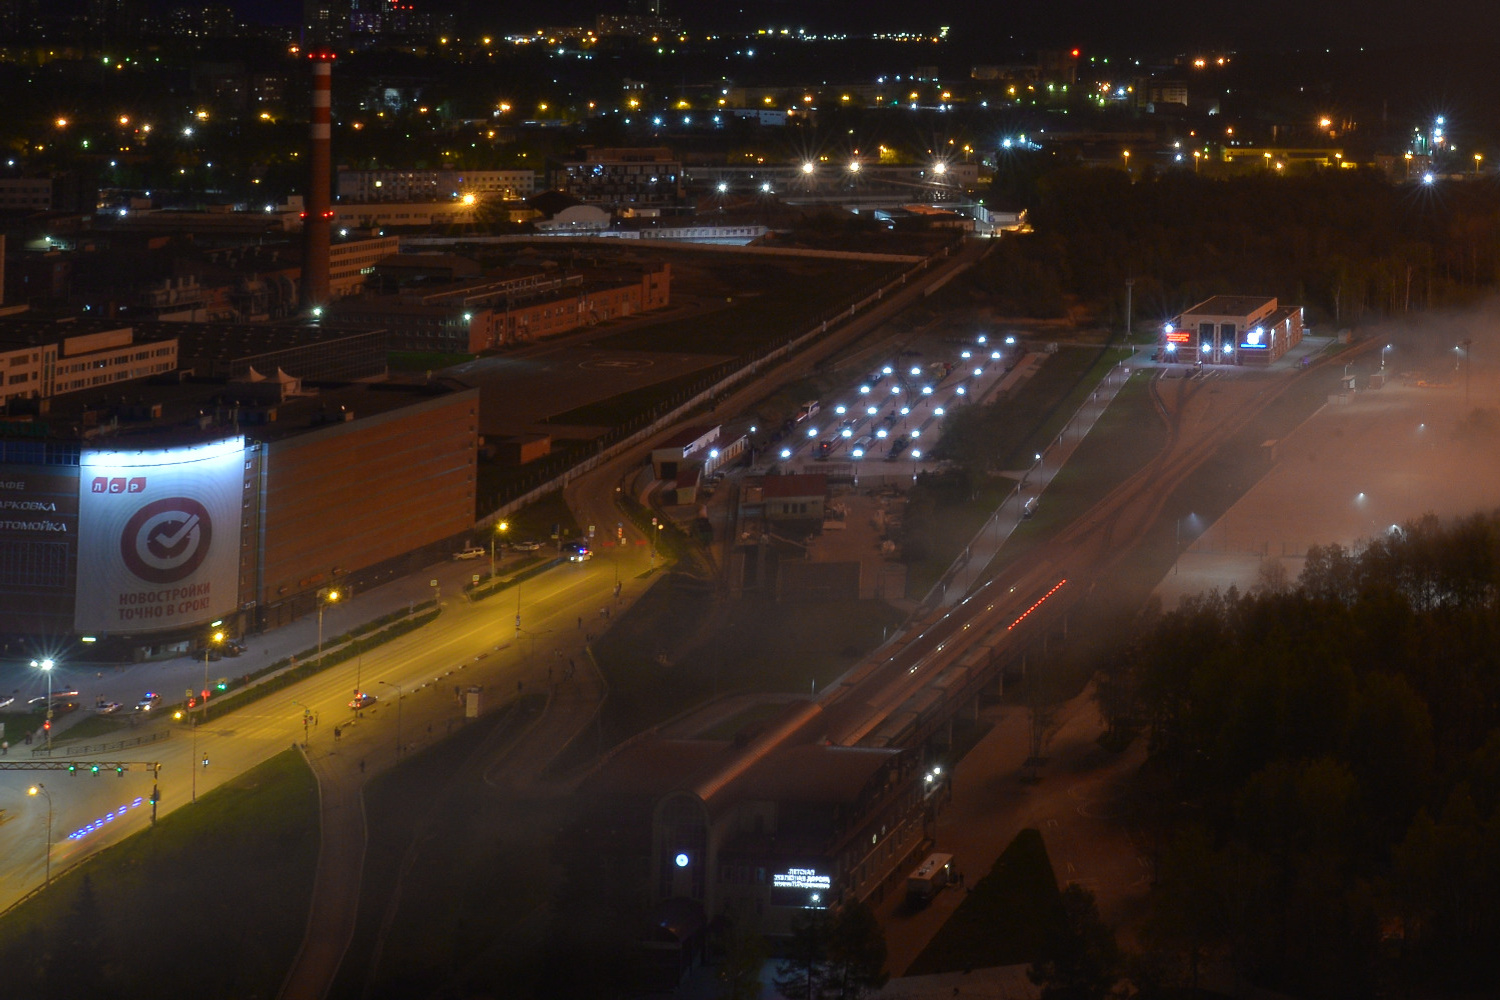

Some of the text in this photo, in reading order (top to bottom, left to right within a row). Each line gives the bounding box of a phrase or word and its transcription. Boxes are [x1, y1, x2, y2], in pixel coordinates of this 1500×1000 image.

[93, 481, 139, 493] ЛСР
[119, 582, 211, 605] НОВОСТРОЙКИ
[118, 597, 210, 620] ТОЧНО В СРОК!
